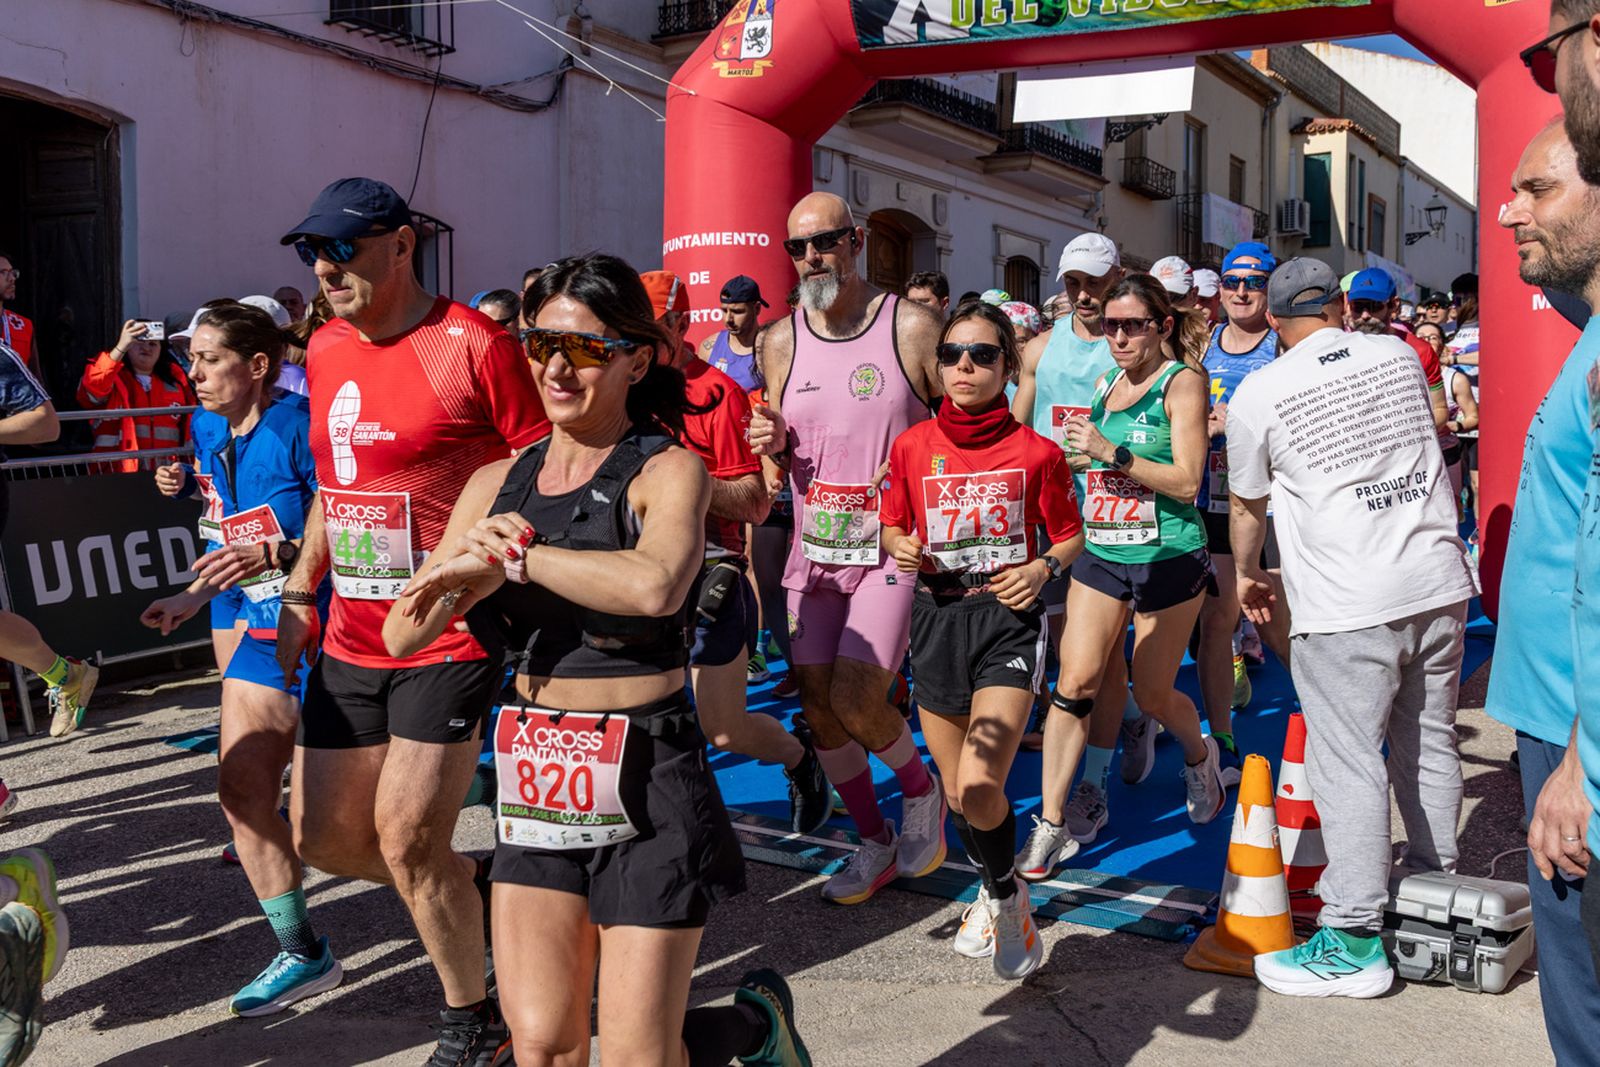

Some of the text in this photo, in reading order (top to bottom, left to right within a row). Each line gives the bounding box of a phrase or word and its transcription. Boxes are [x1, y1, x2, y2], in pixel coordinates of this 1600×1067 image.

[689, 271, 710, 285] DE
[1318, 347, 1352, 366] PONY
[1274, 402, 1282, 410] IN
[1282, 395, 1297, 405] THE
[1298, 386, 1321, 398] EARLY
[1344, 373, 1359, 382] THE
[1360, 365, 1378, 377] ONLY
[1380, 358, 1398, 368] RULE
[1278, 401, 1307, 419] BROKEN
[1307, 394, 1326, 405] NEW
[1326, 386, 1349, 397] YORK
[1349, 380, 1367, 390] WAS
[1367, 375, 1379, 383] TO
[1379, 367, 1398, 379] STAY
[1399, 364, 1409, 372] ON
[1285, 414, 1304, 427] FEET.
[1304, 403, 1327, 417] WHEN
[1328, 395, 1350, 406] PONY
[1351, 387, 1373, 399] FIRST
[1375, 374, 1412, 390] APPEARED
[1290, 422, 1309, 435] WITH
[1309, 407, 1345, 425] ORIGINAL
[1346, 392, 1386, 410] SNEAKERS
[1386, 383, 1419, 396] DESIGNED
[333, 427, 348, 438] 38
[1288, 436, 1305, 448] REAL
[1337, 413, 1355, 424] NEW
[1357, 401, 1391, 417] YORKERS
[1391, 394, 1418, 407] SLIPPED
[1296, 439, 1321, 454] BRAND
[1321, 429, 1341, 441] THEY
[1342, 416, 1383, 433] IDENTIFIED
[1404, 405, 1421, 413] KICKS
[1307, 451, 1318, 459] TO
[1318, 436, 1351, 454] SURVIVE
[1351, 431, 1367, 441] THE
[1367, 423, 1393, 436] TOUGH
[1393, 418, 1408, 428] CITY
[1307, 457, 1326, 470] PONY
[1327, 450, 1344, 461] HAS
[1344, 441, 1368, 455] SINCE
[1368, 428, 1410, 447] SYMBOLIZED
[1323, 465, 1333, 474] OF
[1341, 456, 1359, 467] CITY
[1360, 449, 1379, 461] THAT
[1380, 442, 1403, 454] NEVER
[1403, 439, 1416, 448] LIES
[937, 481, 1009, 498] X CROSS
[1093, 473, 1140, 488] X CROSS
[1355, 471, 1428, 499] PRODUCT OF
[810, 500, 854, 514] PANTANO
[812, 485, 865, 505] X CROSS
[938, 496, 997, 508] PANTANO
[1367, 487, 1430, 511] NEW YORK
[324, 495, 388, 520] X CROSS
[1093, 496, 1140, 521] 272
[224, 522, 234, 539] X
[233, 519, 263, 537] CROSS
[326, 516, 375, 532] PANTANO
[816, 511, 852, 540] 97
[850, 529, 864, 538] 20
[942, 505, 1009, 540] 713
[335, 528, 378, 566] 44
[834, 539, 849, 548] 02
[943, 542, 960, 550] ANA
[25, 526, 199, 606] UNED
[374, 552, 391, 564] 20
[357, 565, 373, 577] 02
[375, 565, 392, 577] 26
[512, 717, 603, 751] X CROSS
[511, 744, 586, 766] PANTANO
[517, 759, 594, 812] 820
[501, 804, 529, 816] MARIA
[530, 809, 549, 820] JOSE
